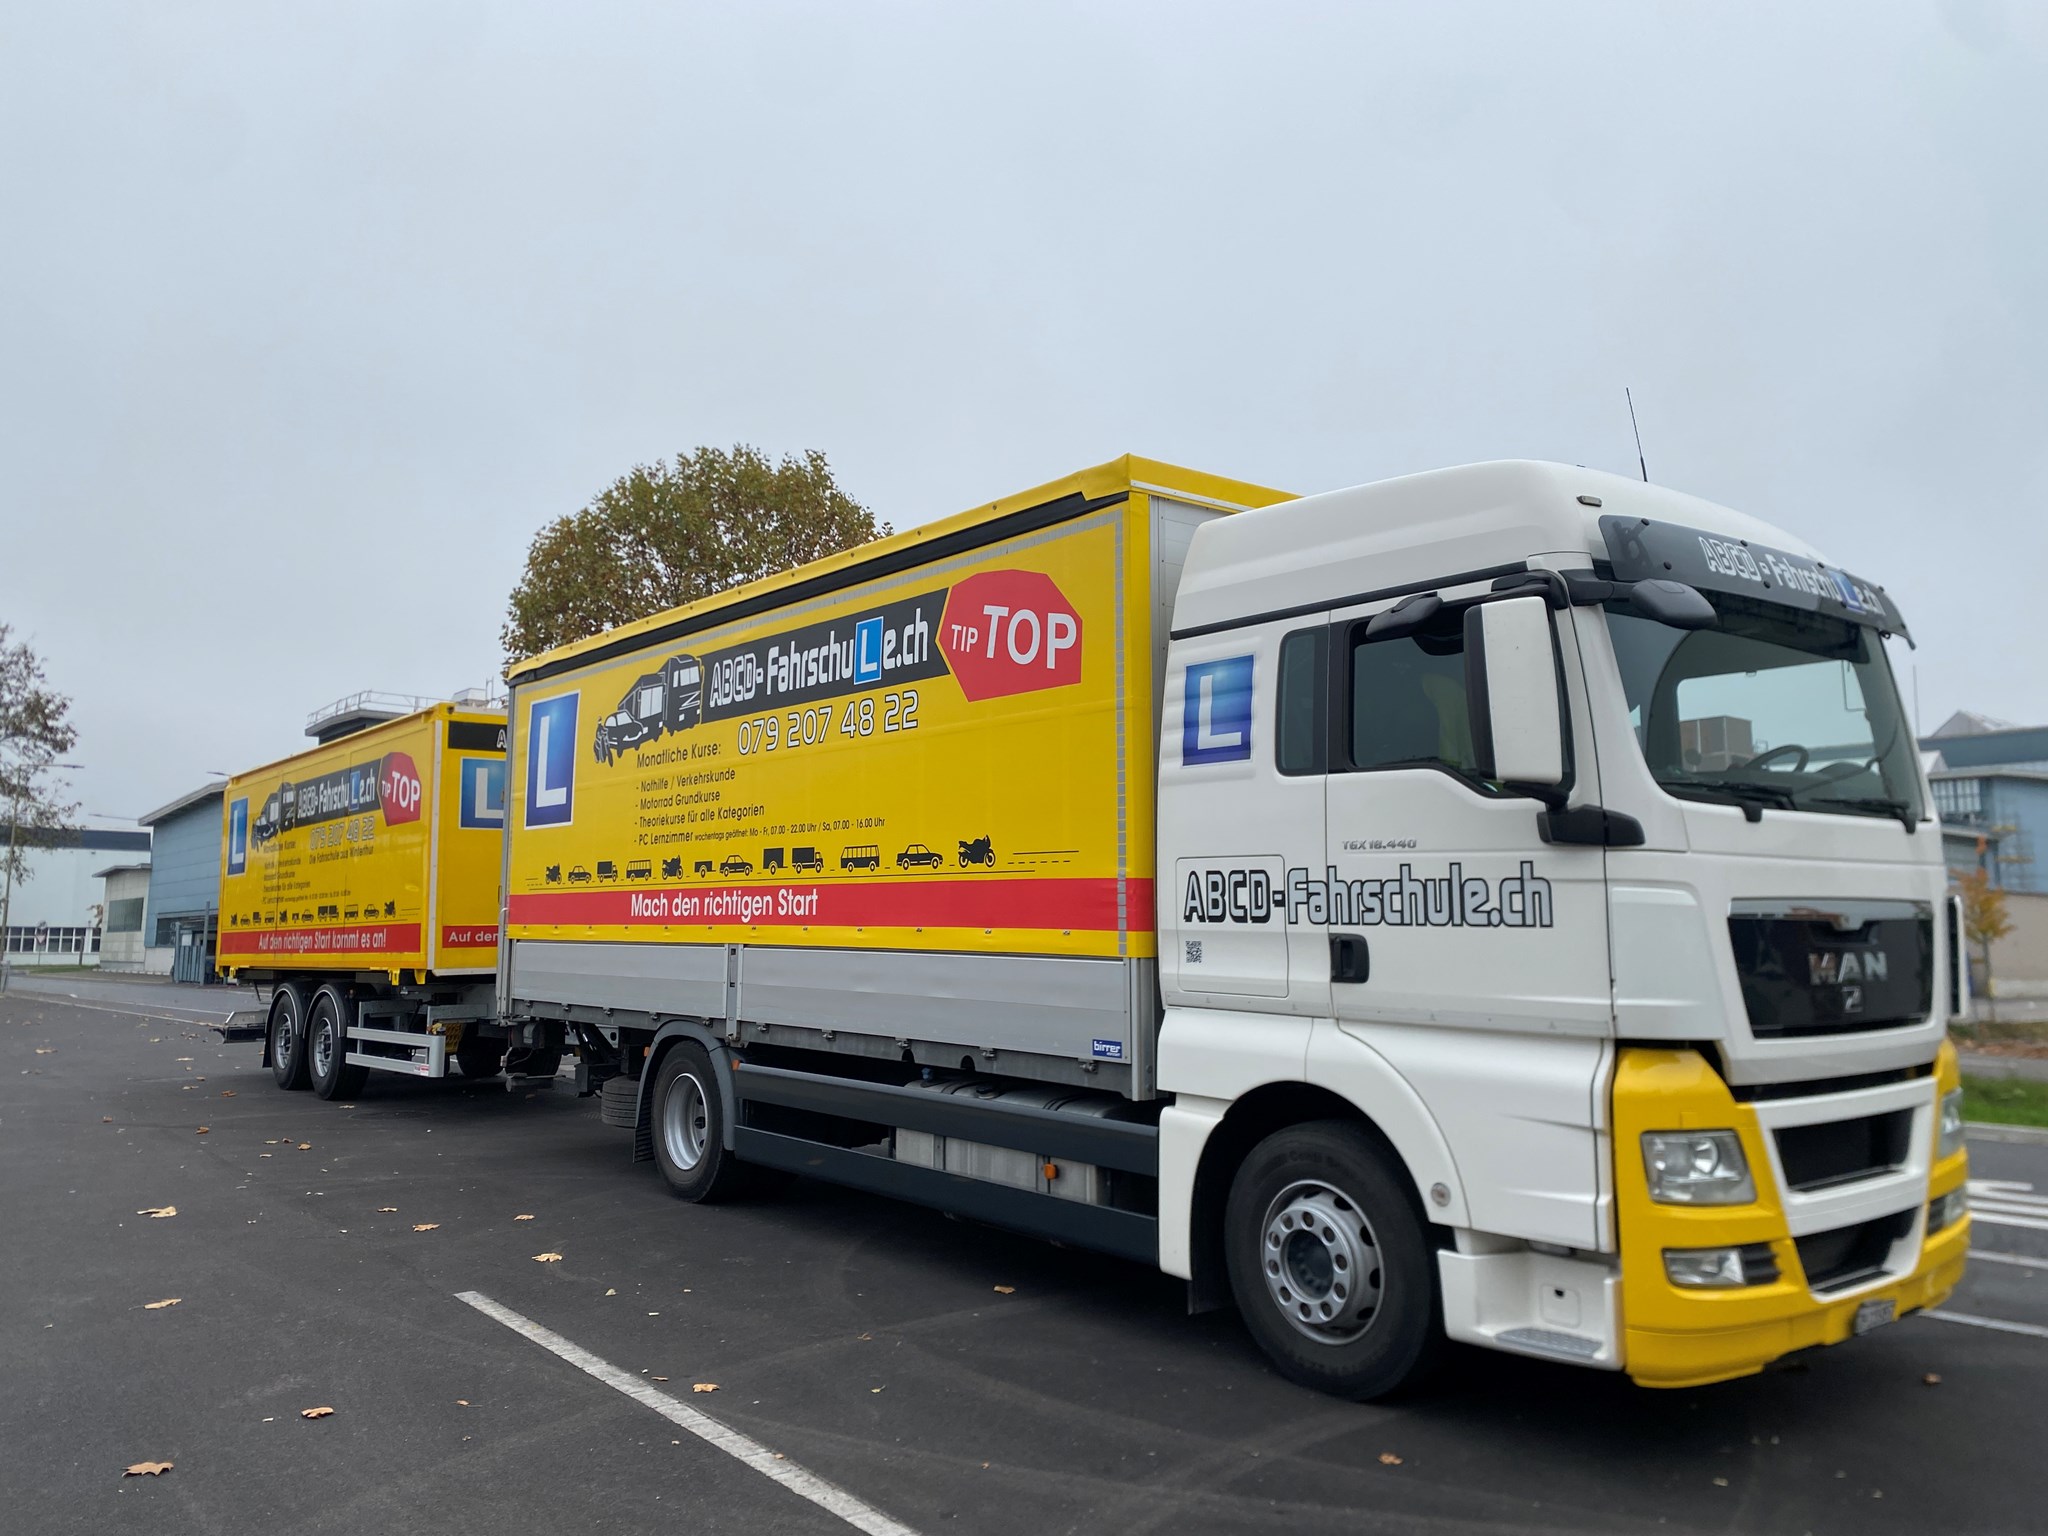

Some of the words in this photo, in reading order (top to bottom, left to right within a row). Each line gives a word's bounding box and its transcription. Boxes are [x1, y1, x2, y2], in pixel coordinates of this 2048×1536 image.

[951, 623, 979, 652] TIP
[983, 604, 1077, 669] TOP
[737, 716, 780, 756] 079
[787, 705, 833, 748] 207
[840, 698, 875, 739] 48
[884, 689, 919, 733] 22
[1197, 674, 1243, 750] L
[535, 715, 567, 808] L
[637, 748, 688, 768] Monatliche
[691, 743, 721, 759] Kurse:
[381, 780, 391, 798] TIP
[392, 770, 421, 812] TOP
[641, 778, 668, 792] Nothilfe
[677, 768, 735, 787] Verkehrskunde
[640, 795, 673, 810] Motorrad
[675, 790, 720, 806] Grundkurse
[640, 813, 685, 828] Theoriekurse
[688, 810, 698, 823] für
[700, 809, 714, 821] alle
[718, 804, 764, 821] Kategorien
[231, 809, 244, 865] L
[310, 827, 326, 850] 079
[327, 822, 345, 848] 207
[346, 819, 359, 843] 48
[362, 816, 375, 841] 22
[639, 834, 648, 846] PC
[651, 831, 693, 845] Lernzimmer
[695, 831, 724, 841] wochentags
[750, 828, 758, 837] Mo
[770, 825, 785, 835] 07.00
[791, 823, 806, 834] 22.00
[806, 822, 817, 833] Uhr
[833, 819, 849, 830] 07.00
[856, 818, 872, 828] 16.00
[874, 817, 885, 827] Uhr
[630, 893, 668, 917] Mach
[672, 892, 699, 917] den
[704, 890, 772, 923] richtigen
[778, 888, 818, 916] Start
[1183, 861, 1553, 928] ABCD-Fahrschule.ch
[259, 934, 269, 950] Auf
[270, 933, 282, 949] den
[283, 931, 313, 953] richtigen
[314, 930, 331, 949] Start
[332, 929, 359, 949] kommt
[360, 934, 370, 948] es
[372, 928, 387, 948] an!
[448, 931, 471, 942] Auf
[1808, 951, 1888, 986] MAN
[1093, 1040, 1121, 1053] birrer
